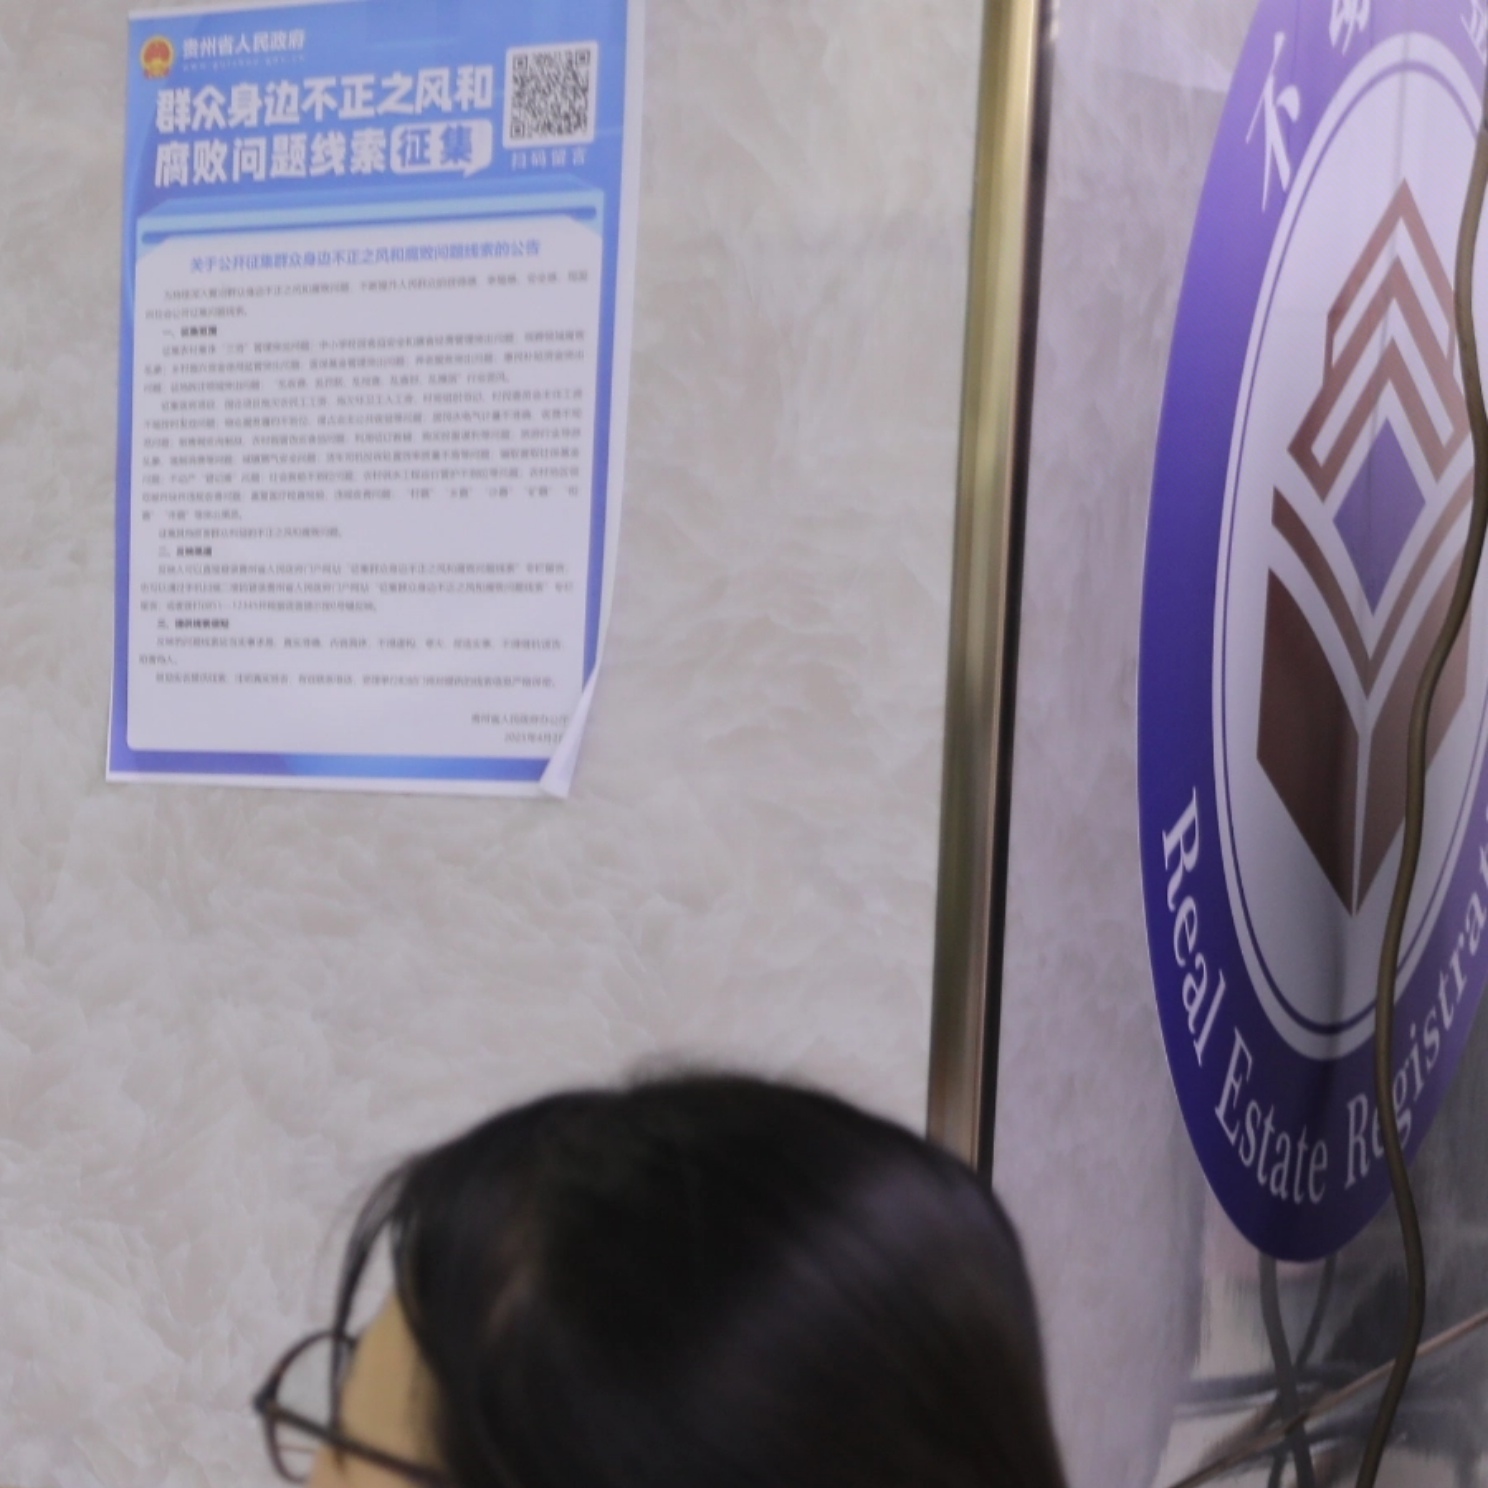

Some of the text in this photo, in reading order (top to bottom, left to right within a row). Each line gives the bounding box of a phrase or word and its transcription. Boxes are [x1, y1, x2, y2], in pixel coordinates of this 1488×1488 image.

[183, 29, 305, 60] 贵州省人民政府
[154, 65, 494, 135] 群众身边不正之风和
[153, 122, 478, 188] 腐败问题线索征集
[1161, 785, 1227, 1068] Real
[1214, 1026, 1329, 1205] Estate
